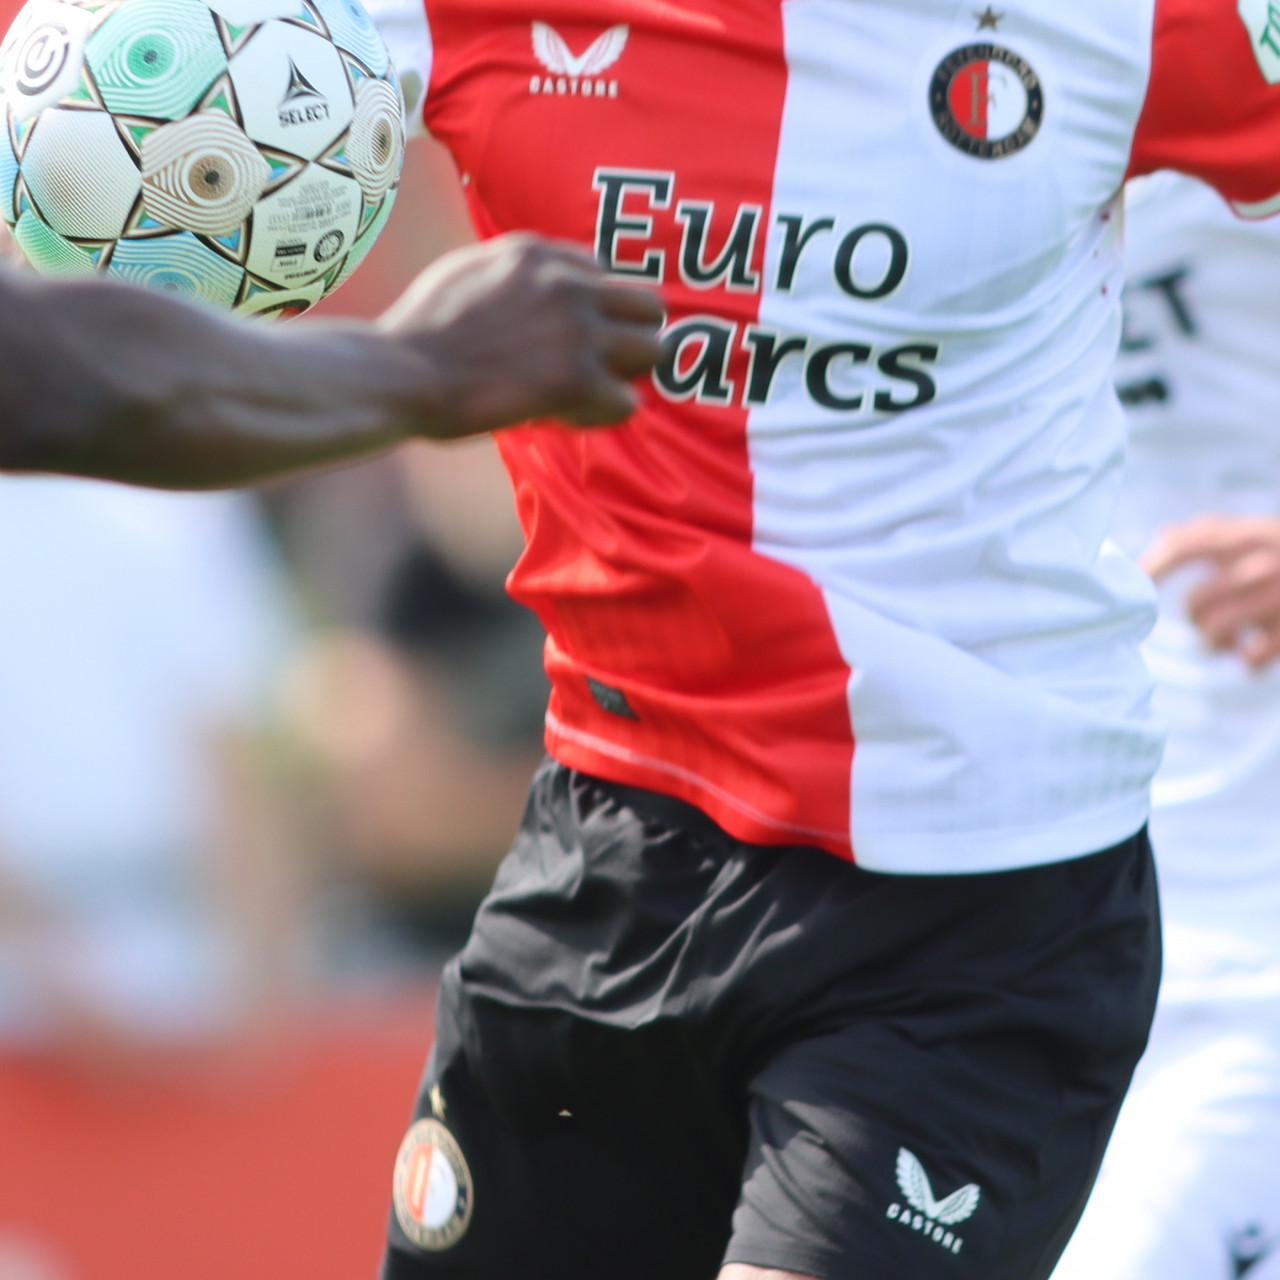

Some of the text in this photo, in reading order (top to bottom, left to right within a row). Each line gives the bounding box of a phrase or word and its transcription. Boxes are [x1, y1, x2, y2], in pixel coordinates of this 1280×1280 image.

[277, 103, 331, 129] SELECT
[592, 166, 912, 302] Euro
[650, 314, 942, 416] arcs
